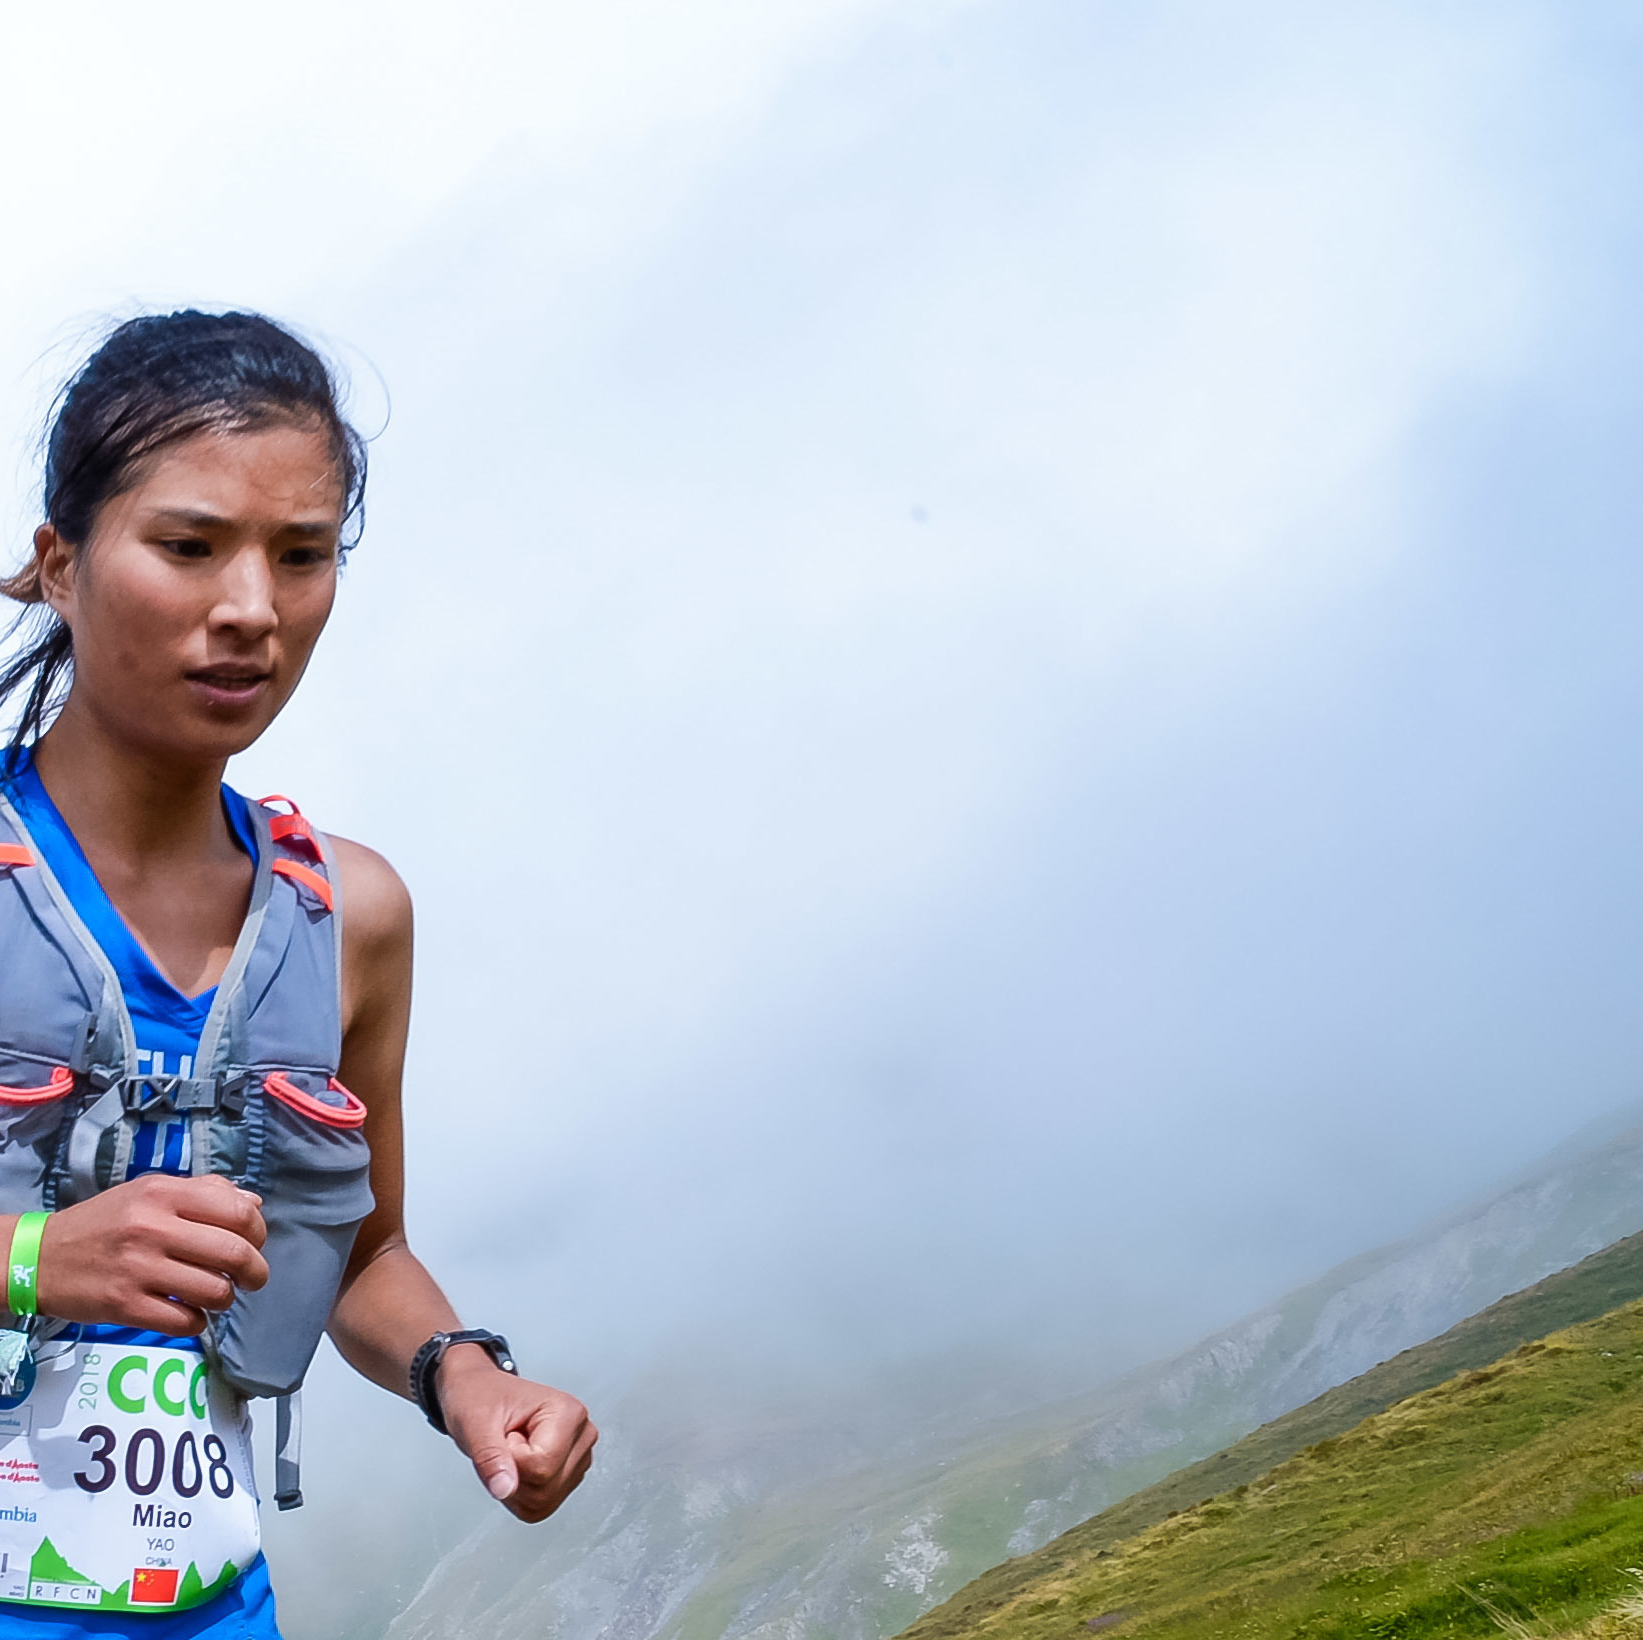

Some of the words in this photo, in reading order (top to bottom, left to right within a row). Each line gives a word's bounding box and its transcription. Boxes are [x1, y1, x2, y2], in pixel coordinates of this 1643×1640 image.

[78, 1353, 101, 1410] 2018
[73, 1424, 234, 1499] 3008
[133, 1503, 192, 1528] Miao
[146, 1537, 175, 1551] YAO
